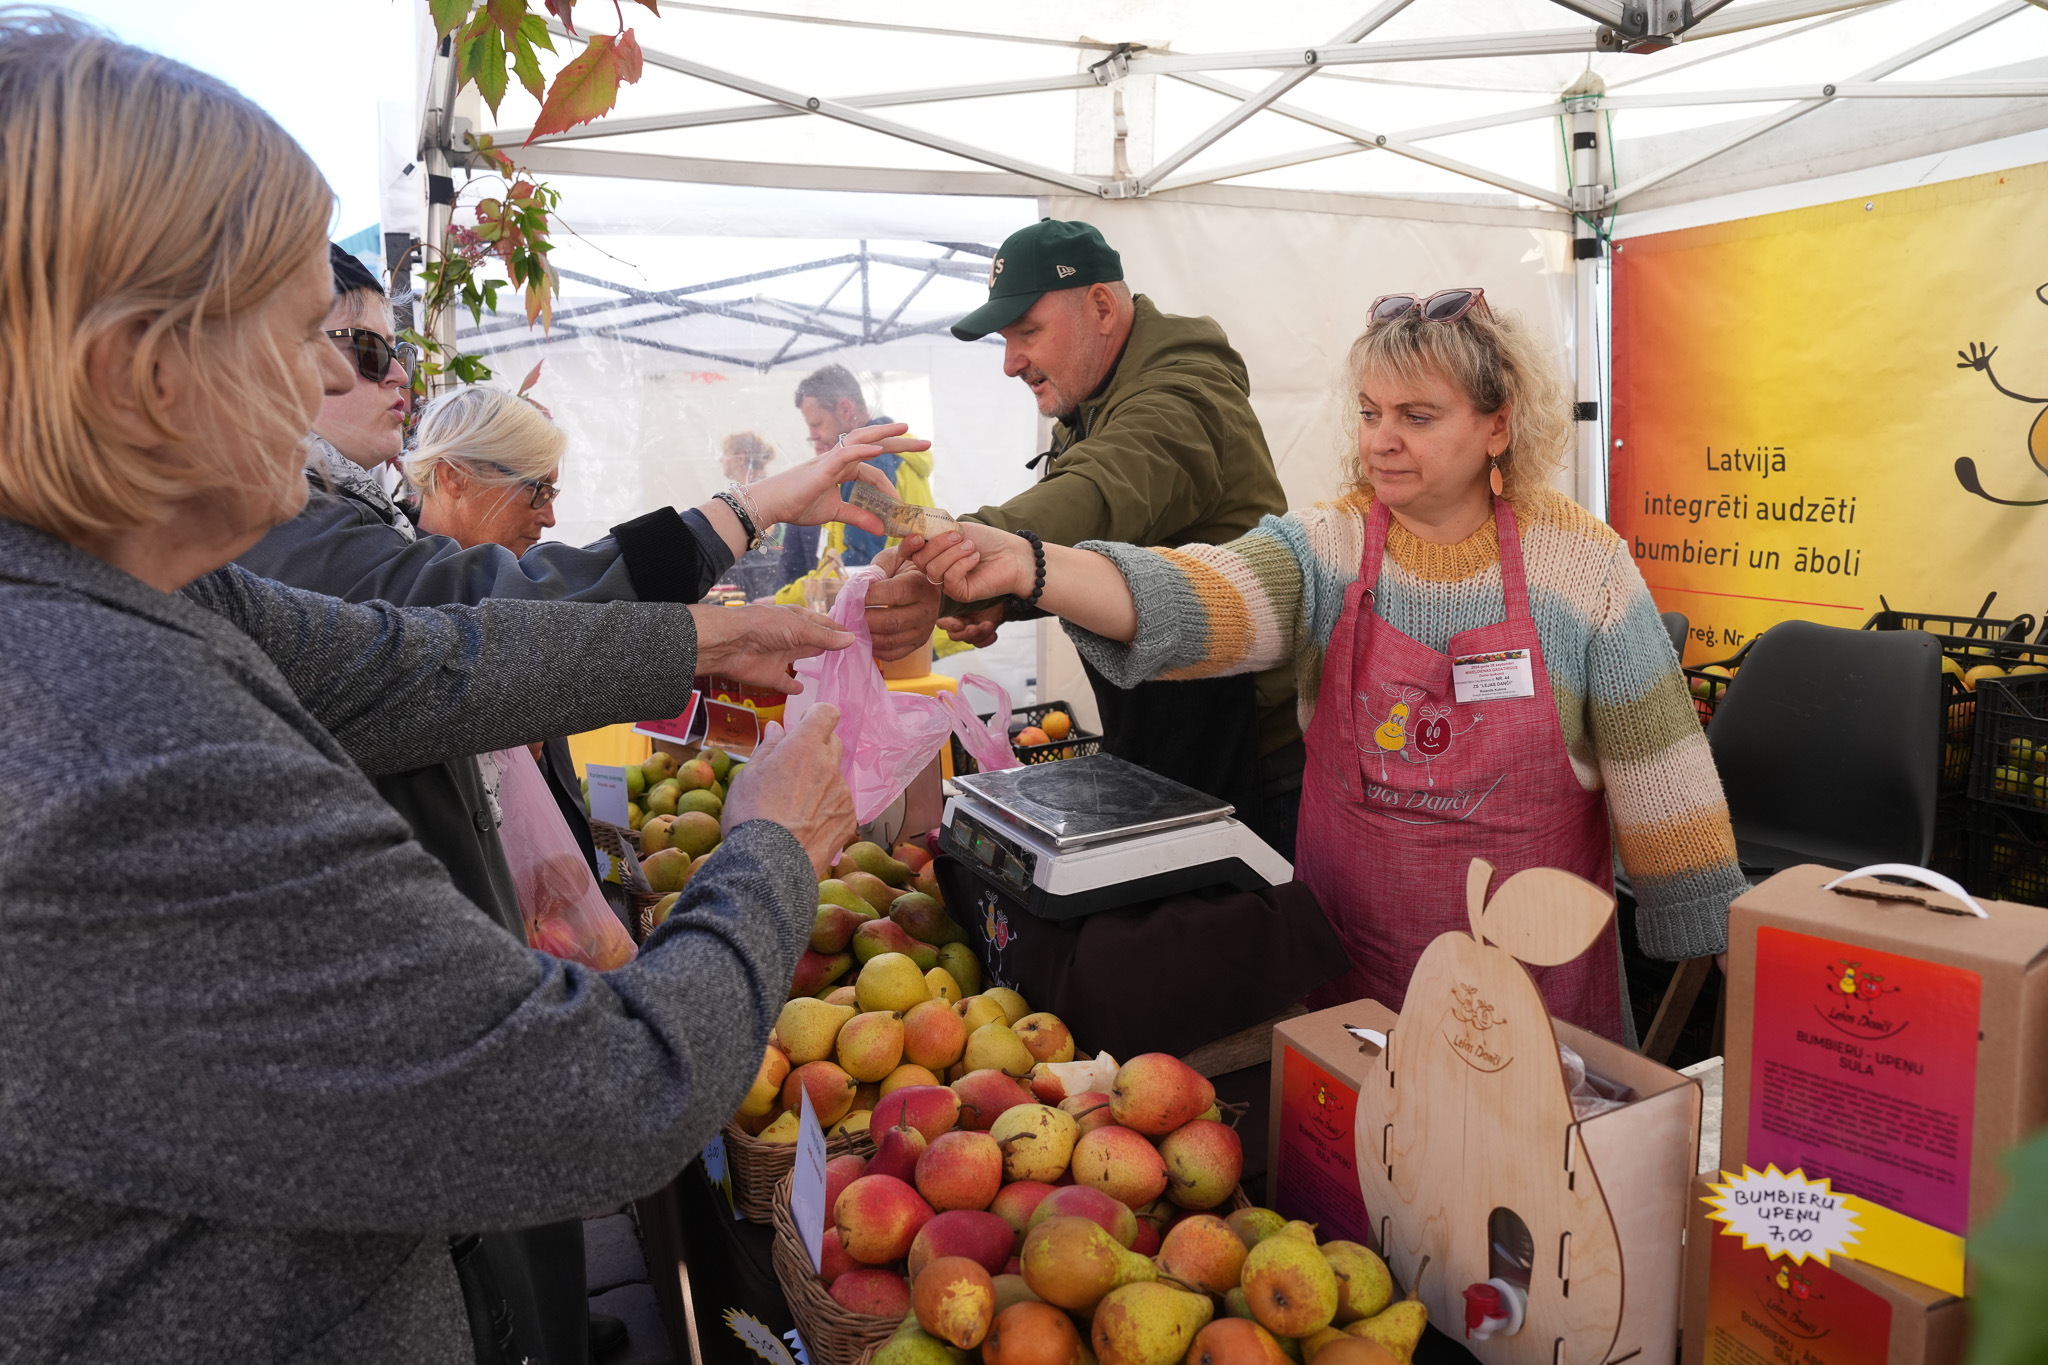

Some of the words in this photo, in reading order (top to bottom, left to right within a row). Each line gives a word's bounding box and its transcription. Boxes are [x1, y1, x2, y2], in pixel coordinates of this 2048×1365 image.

[1706, 446, 1786, 478] Latvijā
[1644, 491, 1748, 523] integrēti
[1756, 496, 1857, 524] audzēti
[1635, 535, 1740, 566] bumbieri
[1749, 549, 1780, 570] un
[1794, 547, 1861, 576] āboli
[1363, 783, 1401, 805] ejas
[1453, 1034, 1473, 1053] Lejas
[1796, 1030, 1863, 1058] BUMBIERU
[1875, 1052, 1924, 1075] UPEŅU
[1839, 1057, 1874, 1076] SULA
[1735, 1190, 1835, 1210] BUMBIERU
[1758, 1207, 1821, 1223] UPEŅU
[1768, 1225, 1812, 1242] 7,00
